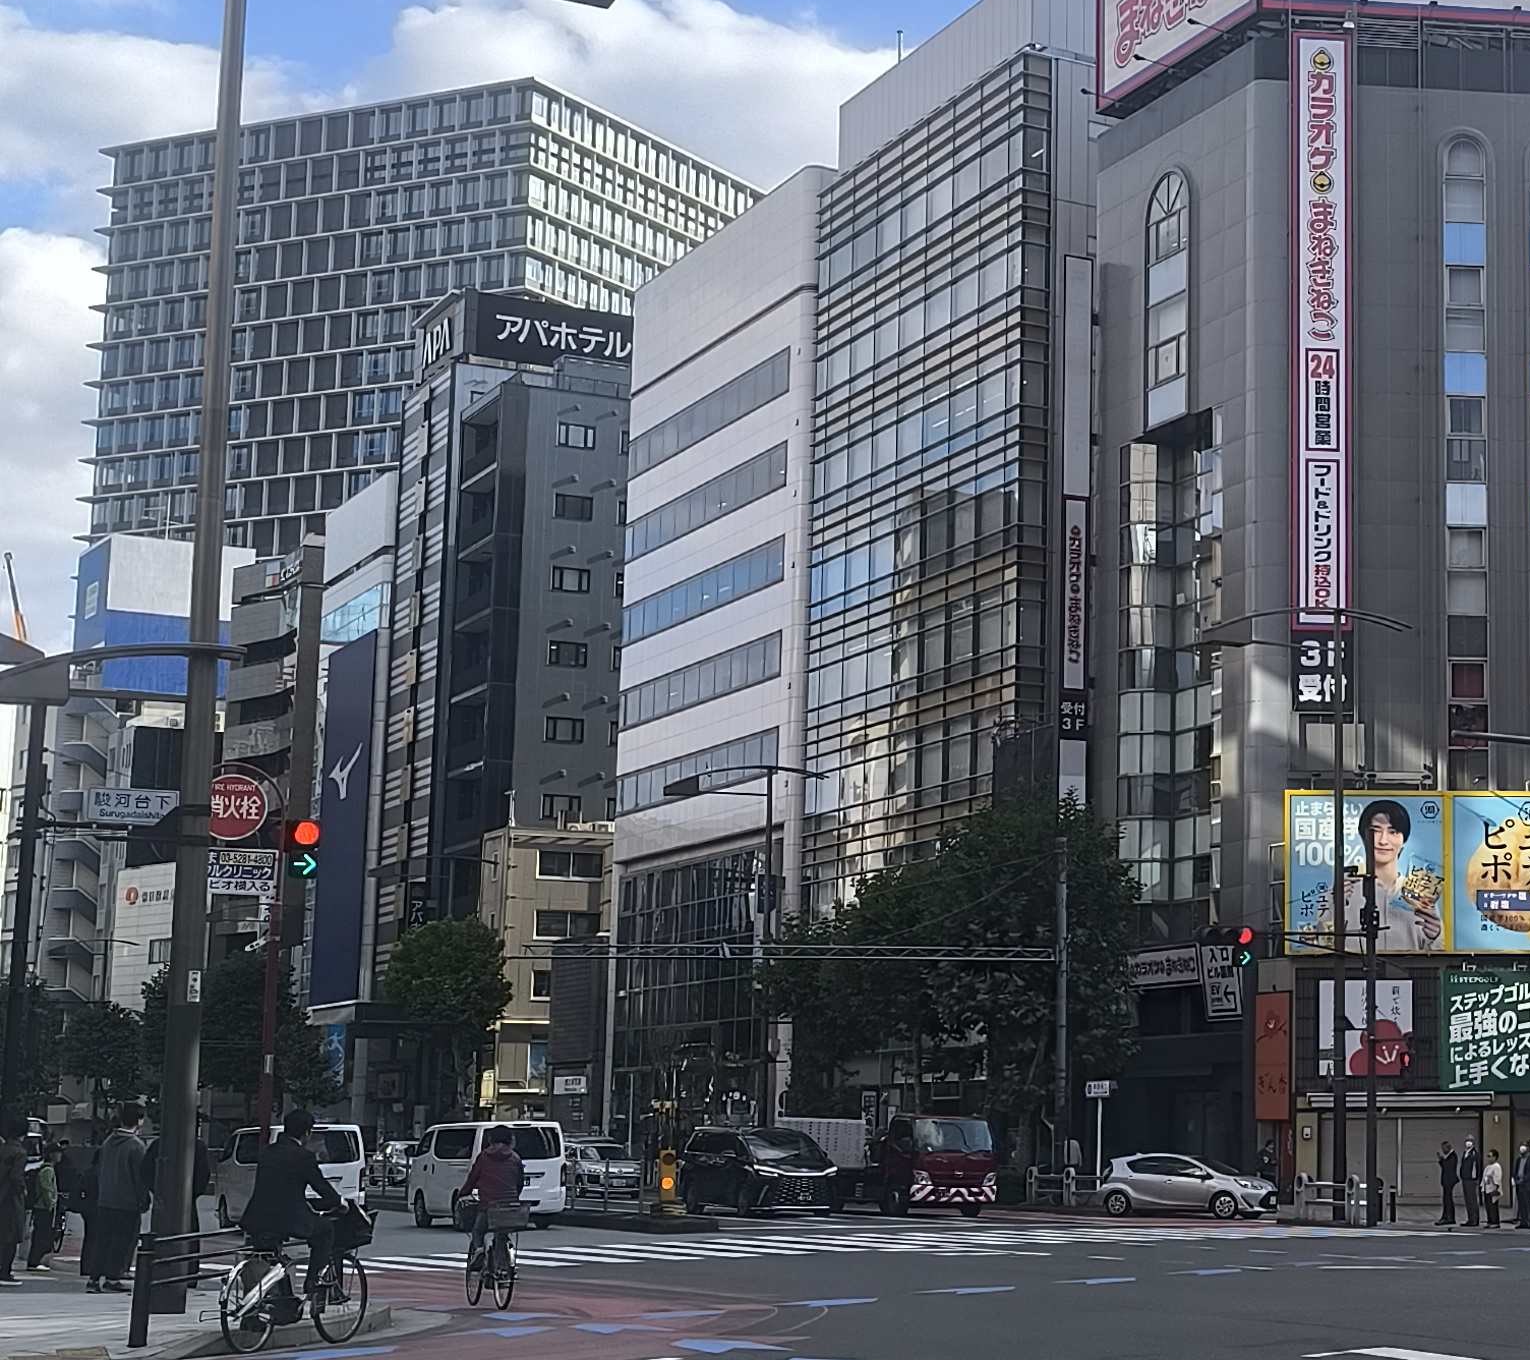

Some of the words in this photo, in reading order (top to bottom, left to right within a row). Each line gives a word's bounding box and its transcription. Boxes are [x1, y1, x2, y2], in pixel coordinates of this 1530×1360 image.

[1307, 70, 1337, 173] カラオケ
[1306, 196, 1339, 342] まねきねこ
[421, 317, 451, 370] APA
[495, 313, 632, 359] アパホテル
[1308, 353, 1336, 447] 24時間営業
[1298, 673, 1348, 703] 受付
[1060, 701, 1085, 716] 受付
[1061, 717, 1085, 732] 3F
[94, 791, 173, 809] 駿河台下
[210, 794, 263, 821] 消火栓
[1294, 841, 1364, 867] 100%
[1209, 947, 1230, 964] 入口
